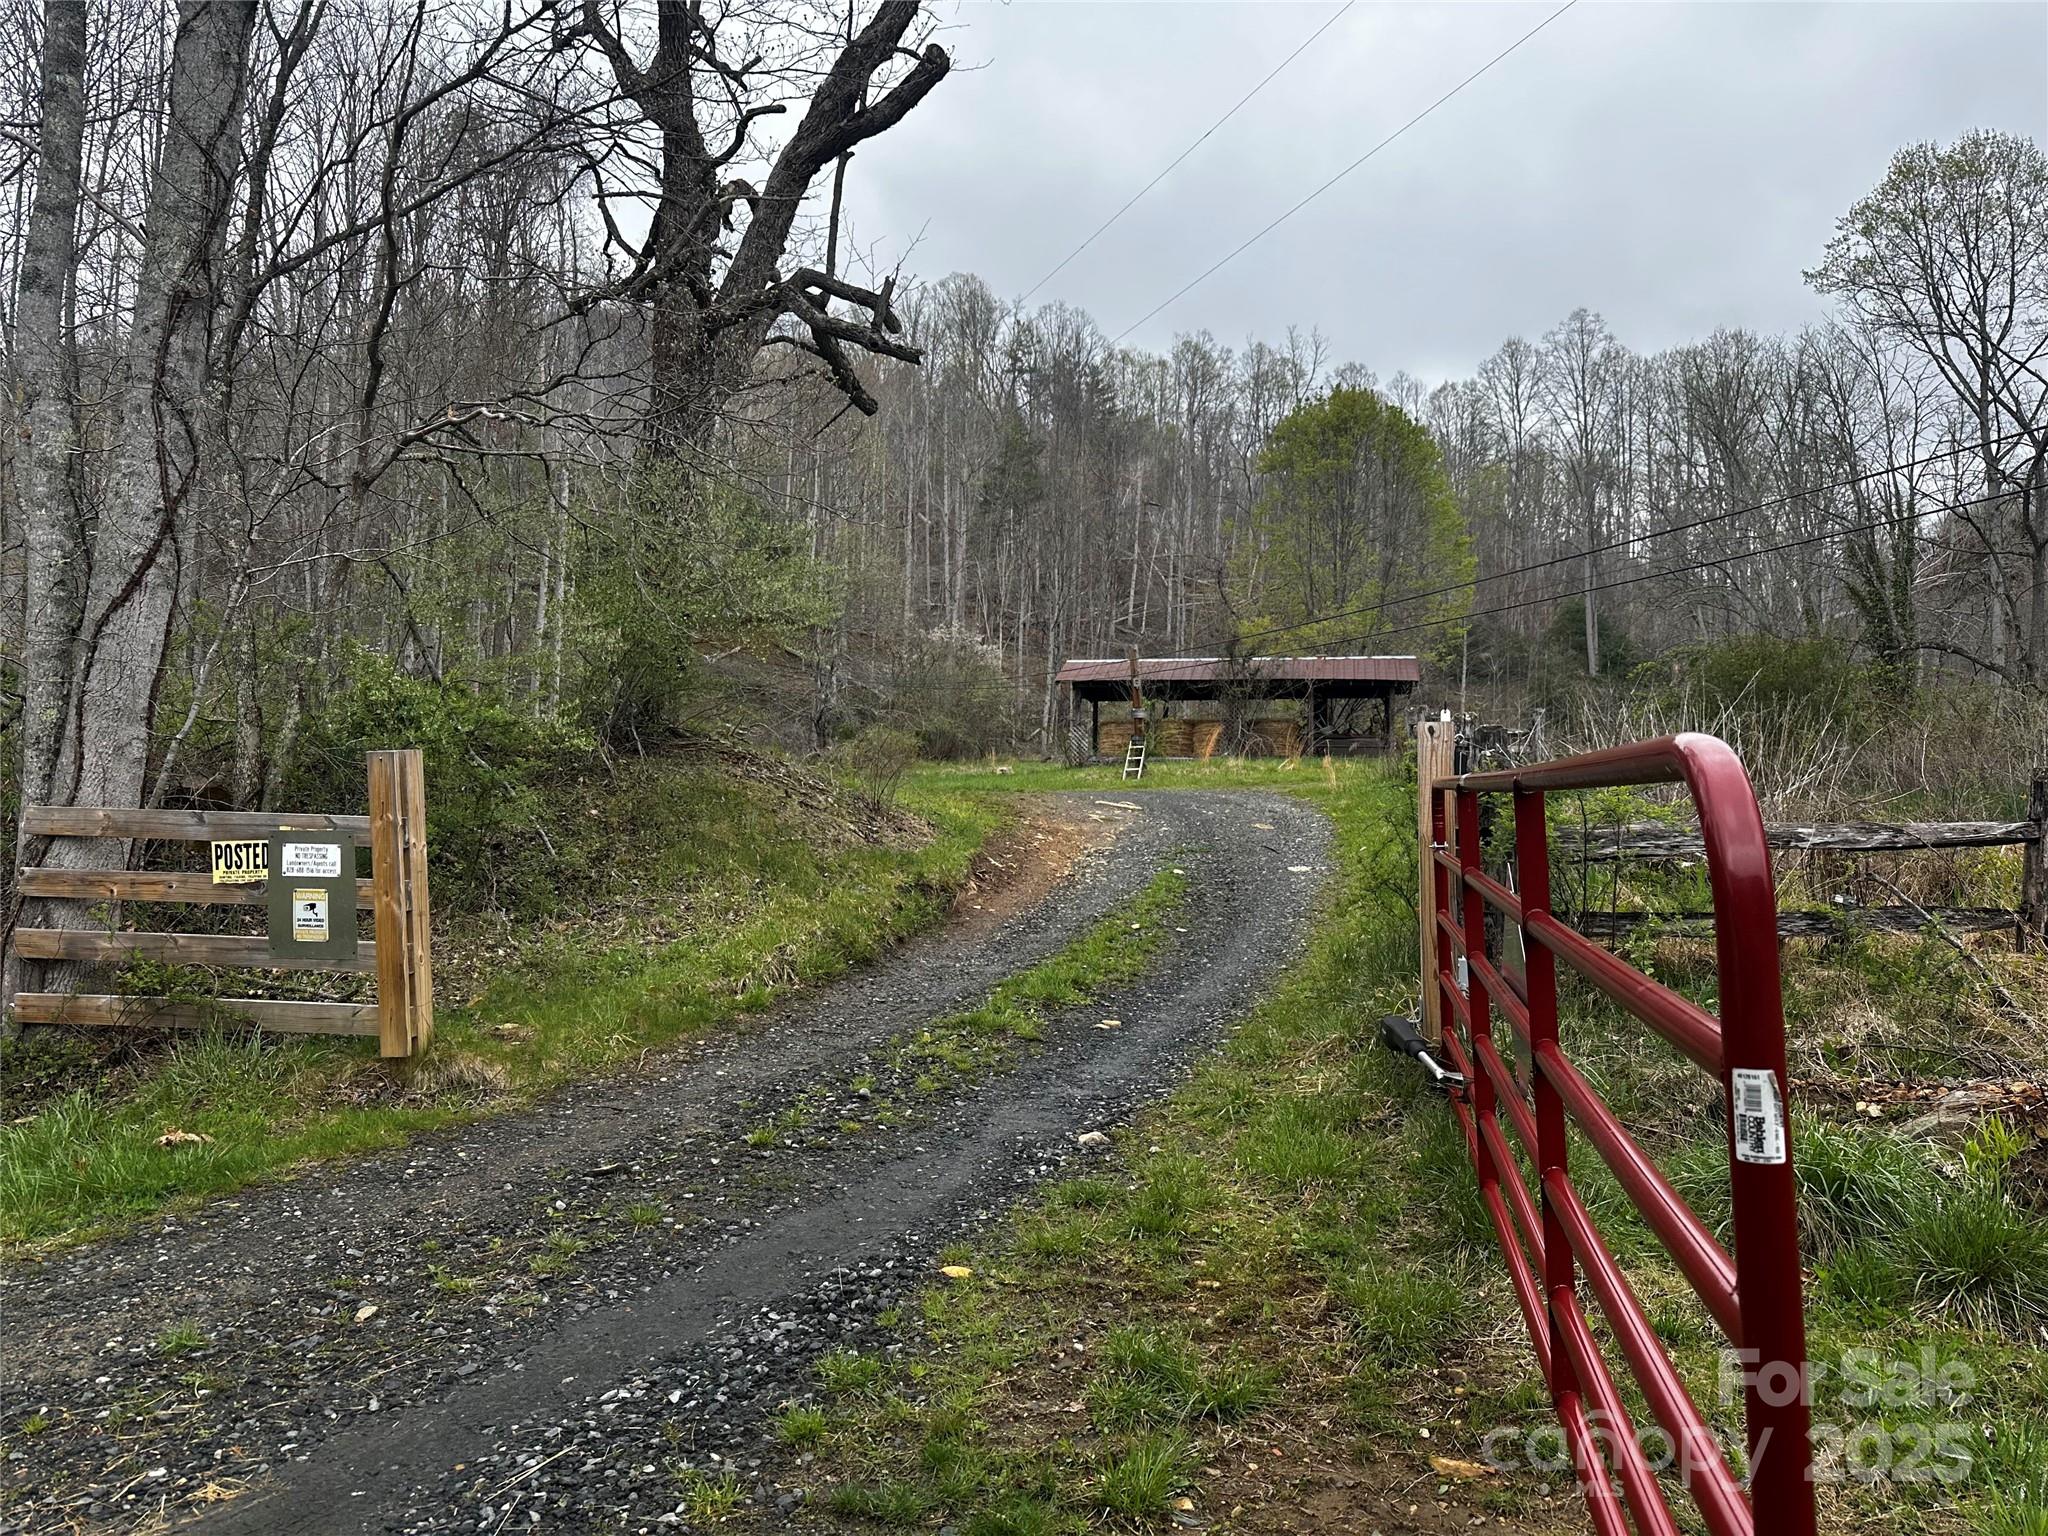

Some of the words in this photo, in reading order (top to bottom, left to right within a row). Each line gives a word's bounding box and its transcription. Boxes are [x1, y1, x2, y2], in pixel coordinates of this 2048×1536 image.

[214, 843, 269, 870] POSTED
[311, 846, 329, 854] Property
[1747, 1115, 1758, 1153] COUNTRY
[1755, 1116, 1766, 1154] Behlen
